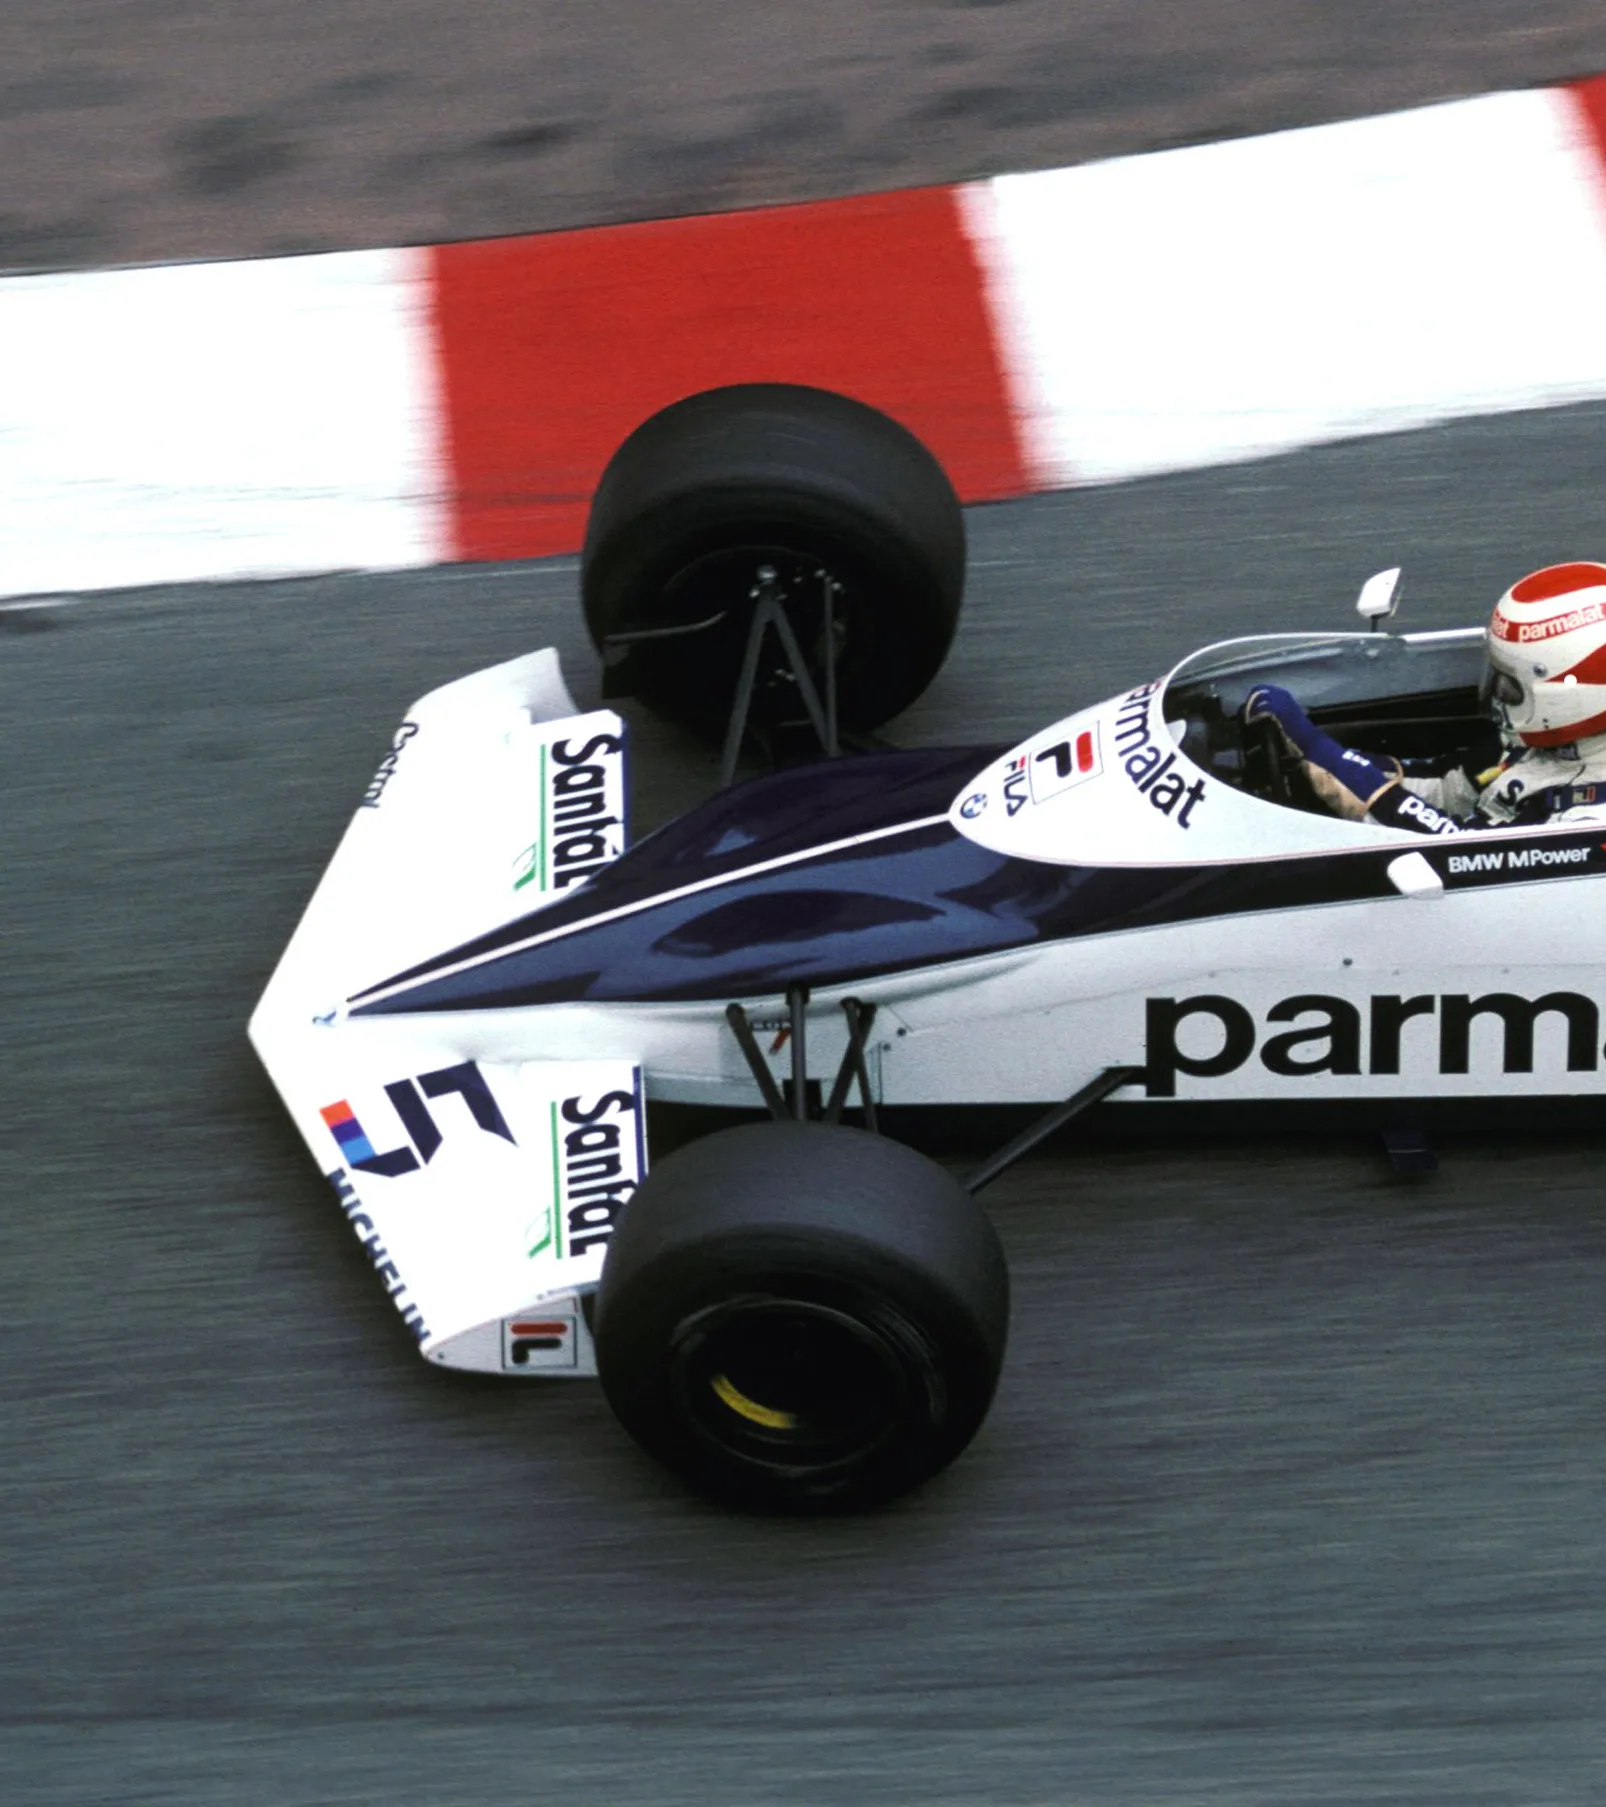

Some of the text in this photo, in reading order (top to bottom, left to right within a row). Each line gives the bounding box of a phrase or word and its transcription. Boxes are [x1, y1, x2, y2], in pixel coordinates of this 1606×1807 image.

[1518, 603, 1606, 642] parmalat
[1003, 755, 1028, 817] FILA
[1114, 681, 1207, 829] armalat
[1448, 853, 1503, 874] BMW
[327, 1167, 432, 1342] MICHELIN
